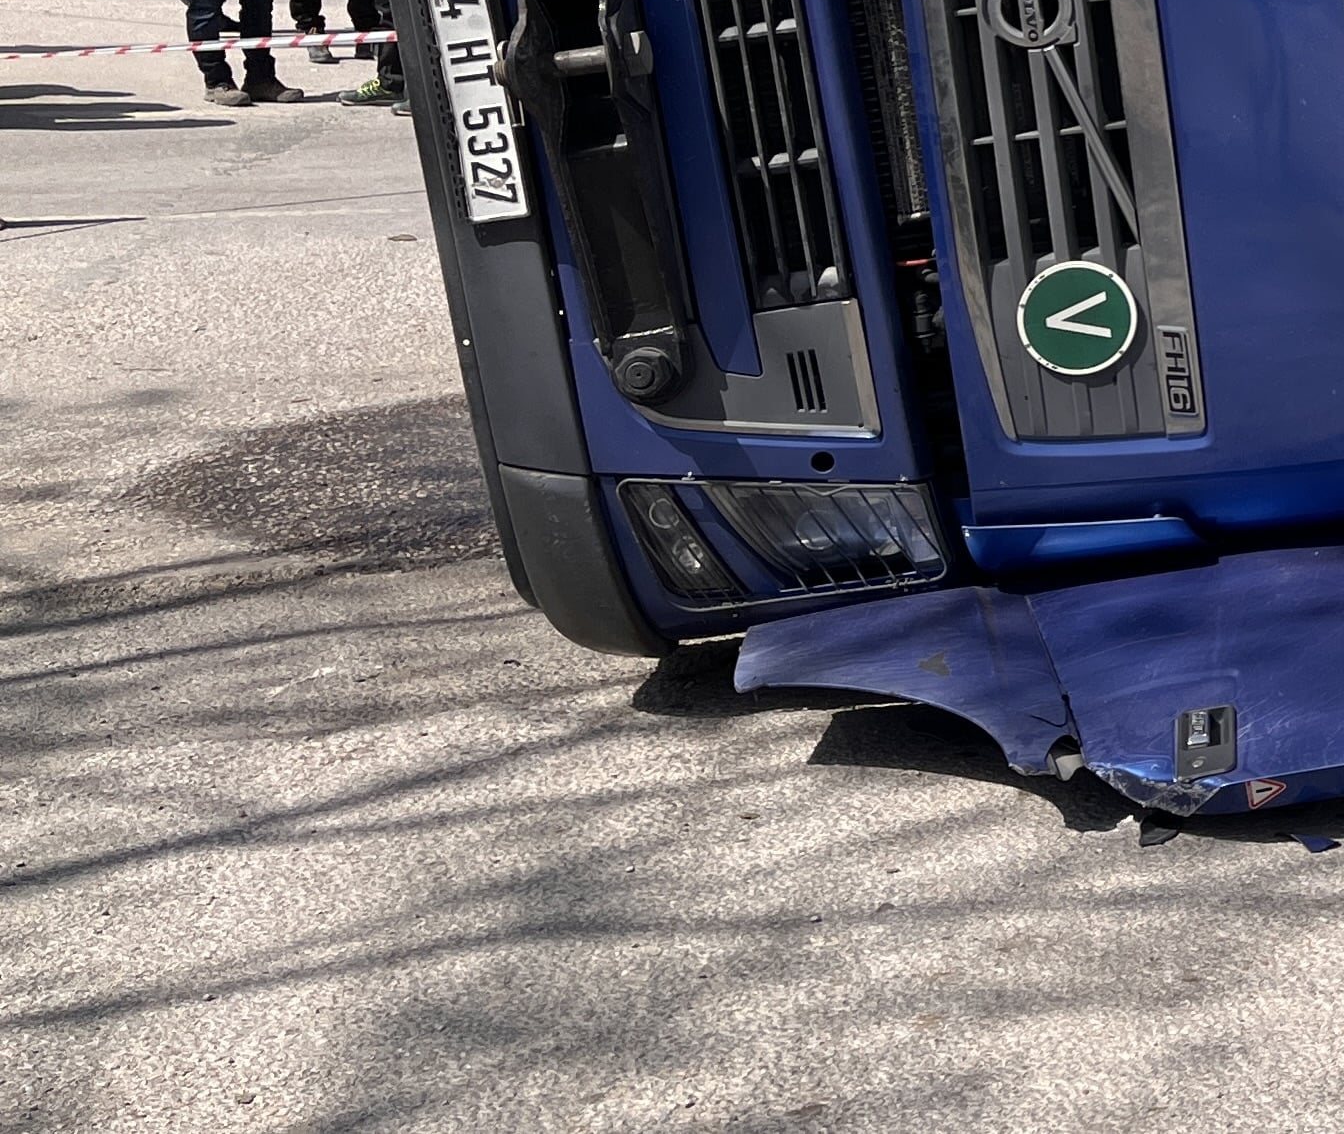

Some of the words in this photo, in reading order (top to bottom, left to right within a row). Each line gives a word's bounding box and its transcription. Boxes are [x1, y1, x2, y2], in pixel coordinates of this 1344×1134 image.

[447, 38, 497, 87] HT
[462, 105, 519, 204] 5327
[1045, 291, 1113, 339] V
[1162, 330, 1194, 412] FH16
